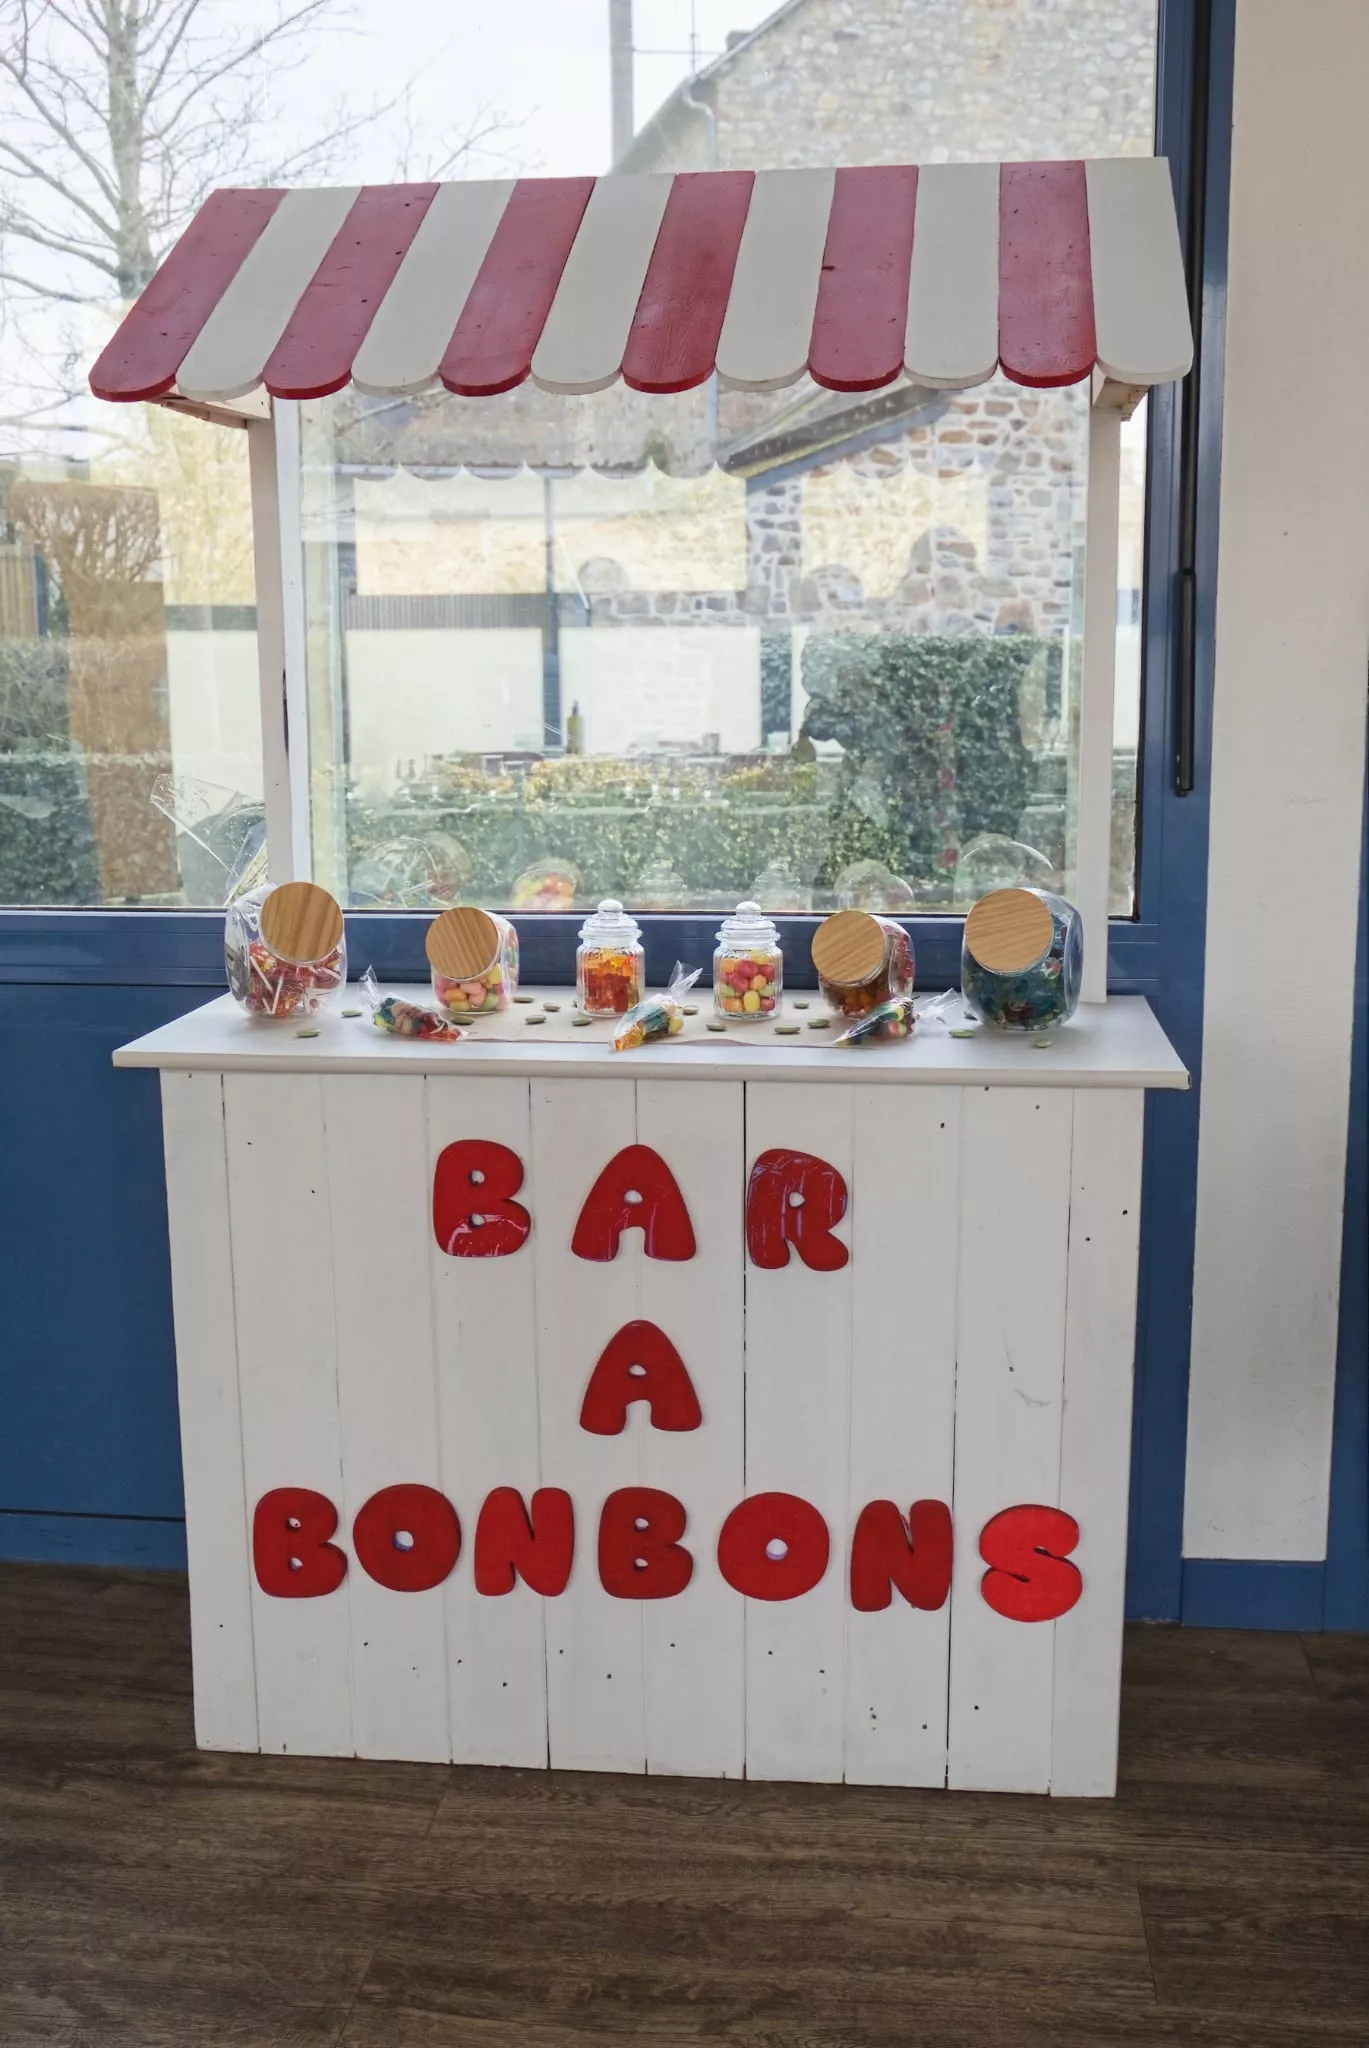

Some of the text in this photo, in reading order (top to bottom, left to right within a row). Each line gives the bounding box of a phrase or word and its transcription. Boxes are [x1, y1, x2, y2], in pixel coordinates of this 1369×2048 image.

[433, 1139, 849, 1272] BAR
[579, 1320, 702, 1436] A
[253, 1483, 1083, 1623] BONBONS
